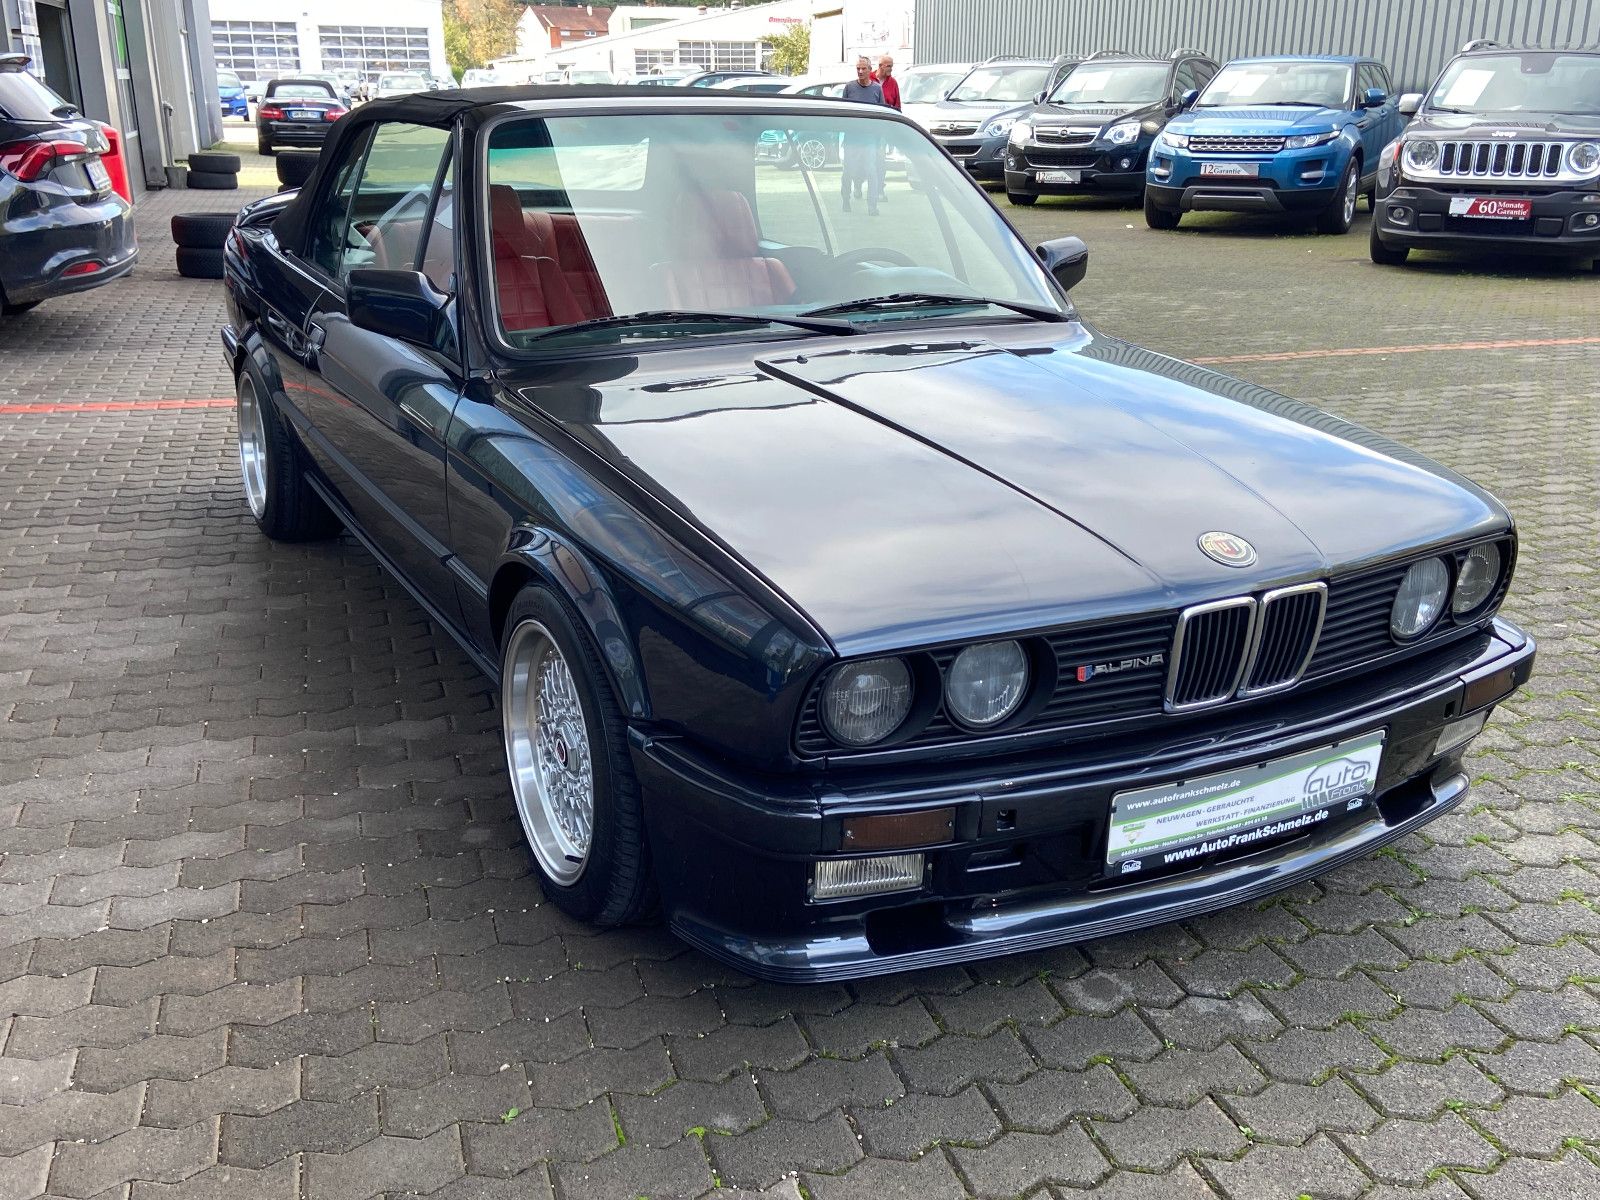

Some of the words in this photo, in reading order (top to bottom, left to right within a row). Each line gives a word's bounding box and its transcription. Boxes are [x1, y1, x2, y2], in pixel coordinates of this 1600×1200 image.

[1203, 163, 1214, 175] 12
[1213, 166, 1241, 175] Garantie
[1478, 200, 1498, 215] 60
[1497, 201, 1525, 209] Monate
[1093, 653, 1164, 676] ALPINA
[1307, 764, 1367, 795] auto
[1126, 779, 1241, 811] www.autofrankschmelz.de
[1156, 808, 1202, 825] NEUWAGEN
[1206, 795, 1256, 813] GEBRAUCHTE
[1195, 811, 1240, 828] WERKSTATT
[1243, 795, 1297, 816] FINANZIERUNG
[1163, 809, 1329, 864] www.AutoFrankSchmelz.de
